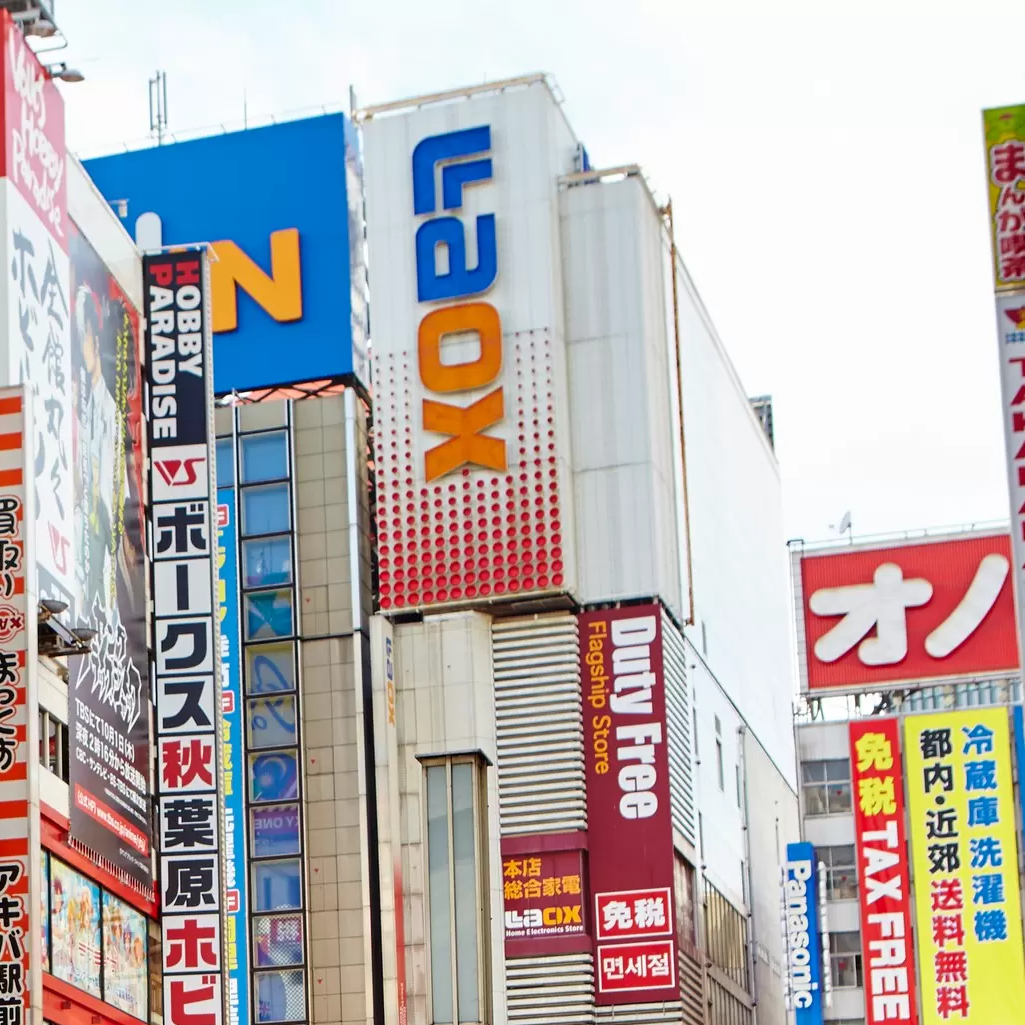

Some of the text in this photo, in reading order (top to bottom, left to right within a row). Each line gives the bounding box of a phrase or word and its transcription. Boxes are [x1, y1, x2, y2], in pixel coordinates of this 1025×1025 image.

[149, 262, 178, 441] PARADISE
[176, 260, 203, 379] HOBBY
[587, 620, 612, 776] Flagship Store
[608, 615, 664, 820] Duty Free
[502, 857, 542, 878] 本店
[503, 874, 582, 900] 総合家電
[602, 895, 667, 932] 免税
[854, 732, 911, 1023] 免税 TAX FREE
[565, 924, 584, 933] Store
[603, 952, 671, 981] 면세점
[786, 858, 813, 1010] Panasonic
